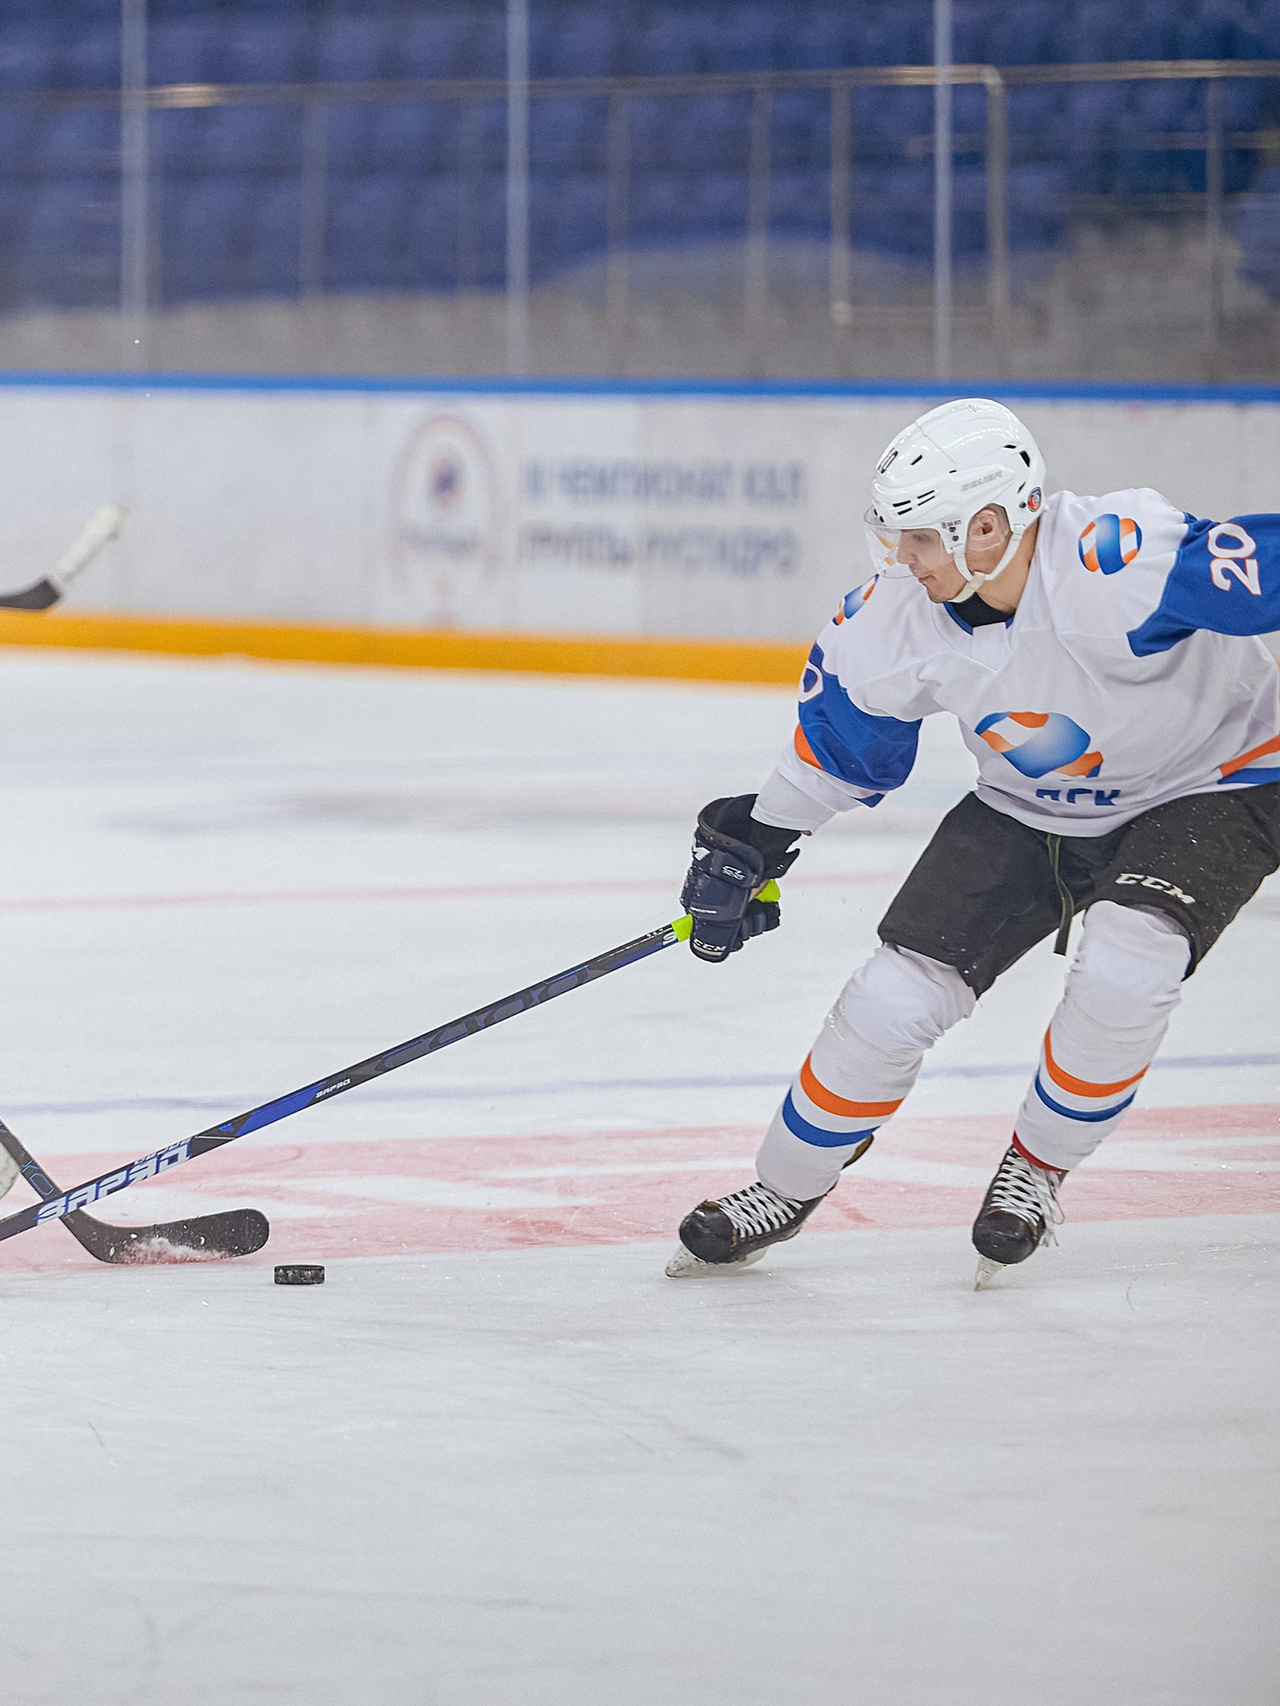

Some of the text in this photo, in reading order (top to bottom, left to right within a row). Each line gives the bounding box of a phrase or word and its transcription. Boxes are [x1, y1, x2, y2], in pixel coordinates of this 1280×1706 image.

[1207, 522, 1262, 596] 20
[1115, 873, 1196, 905] CCM
[693, 937, 727, 952] CCM
